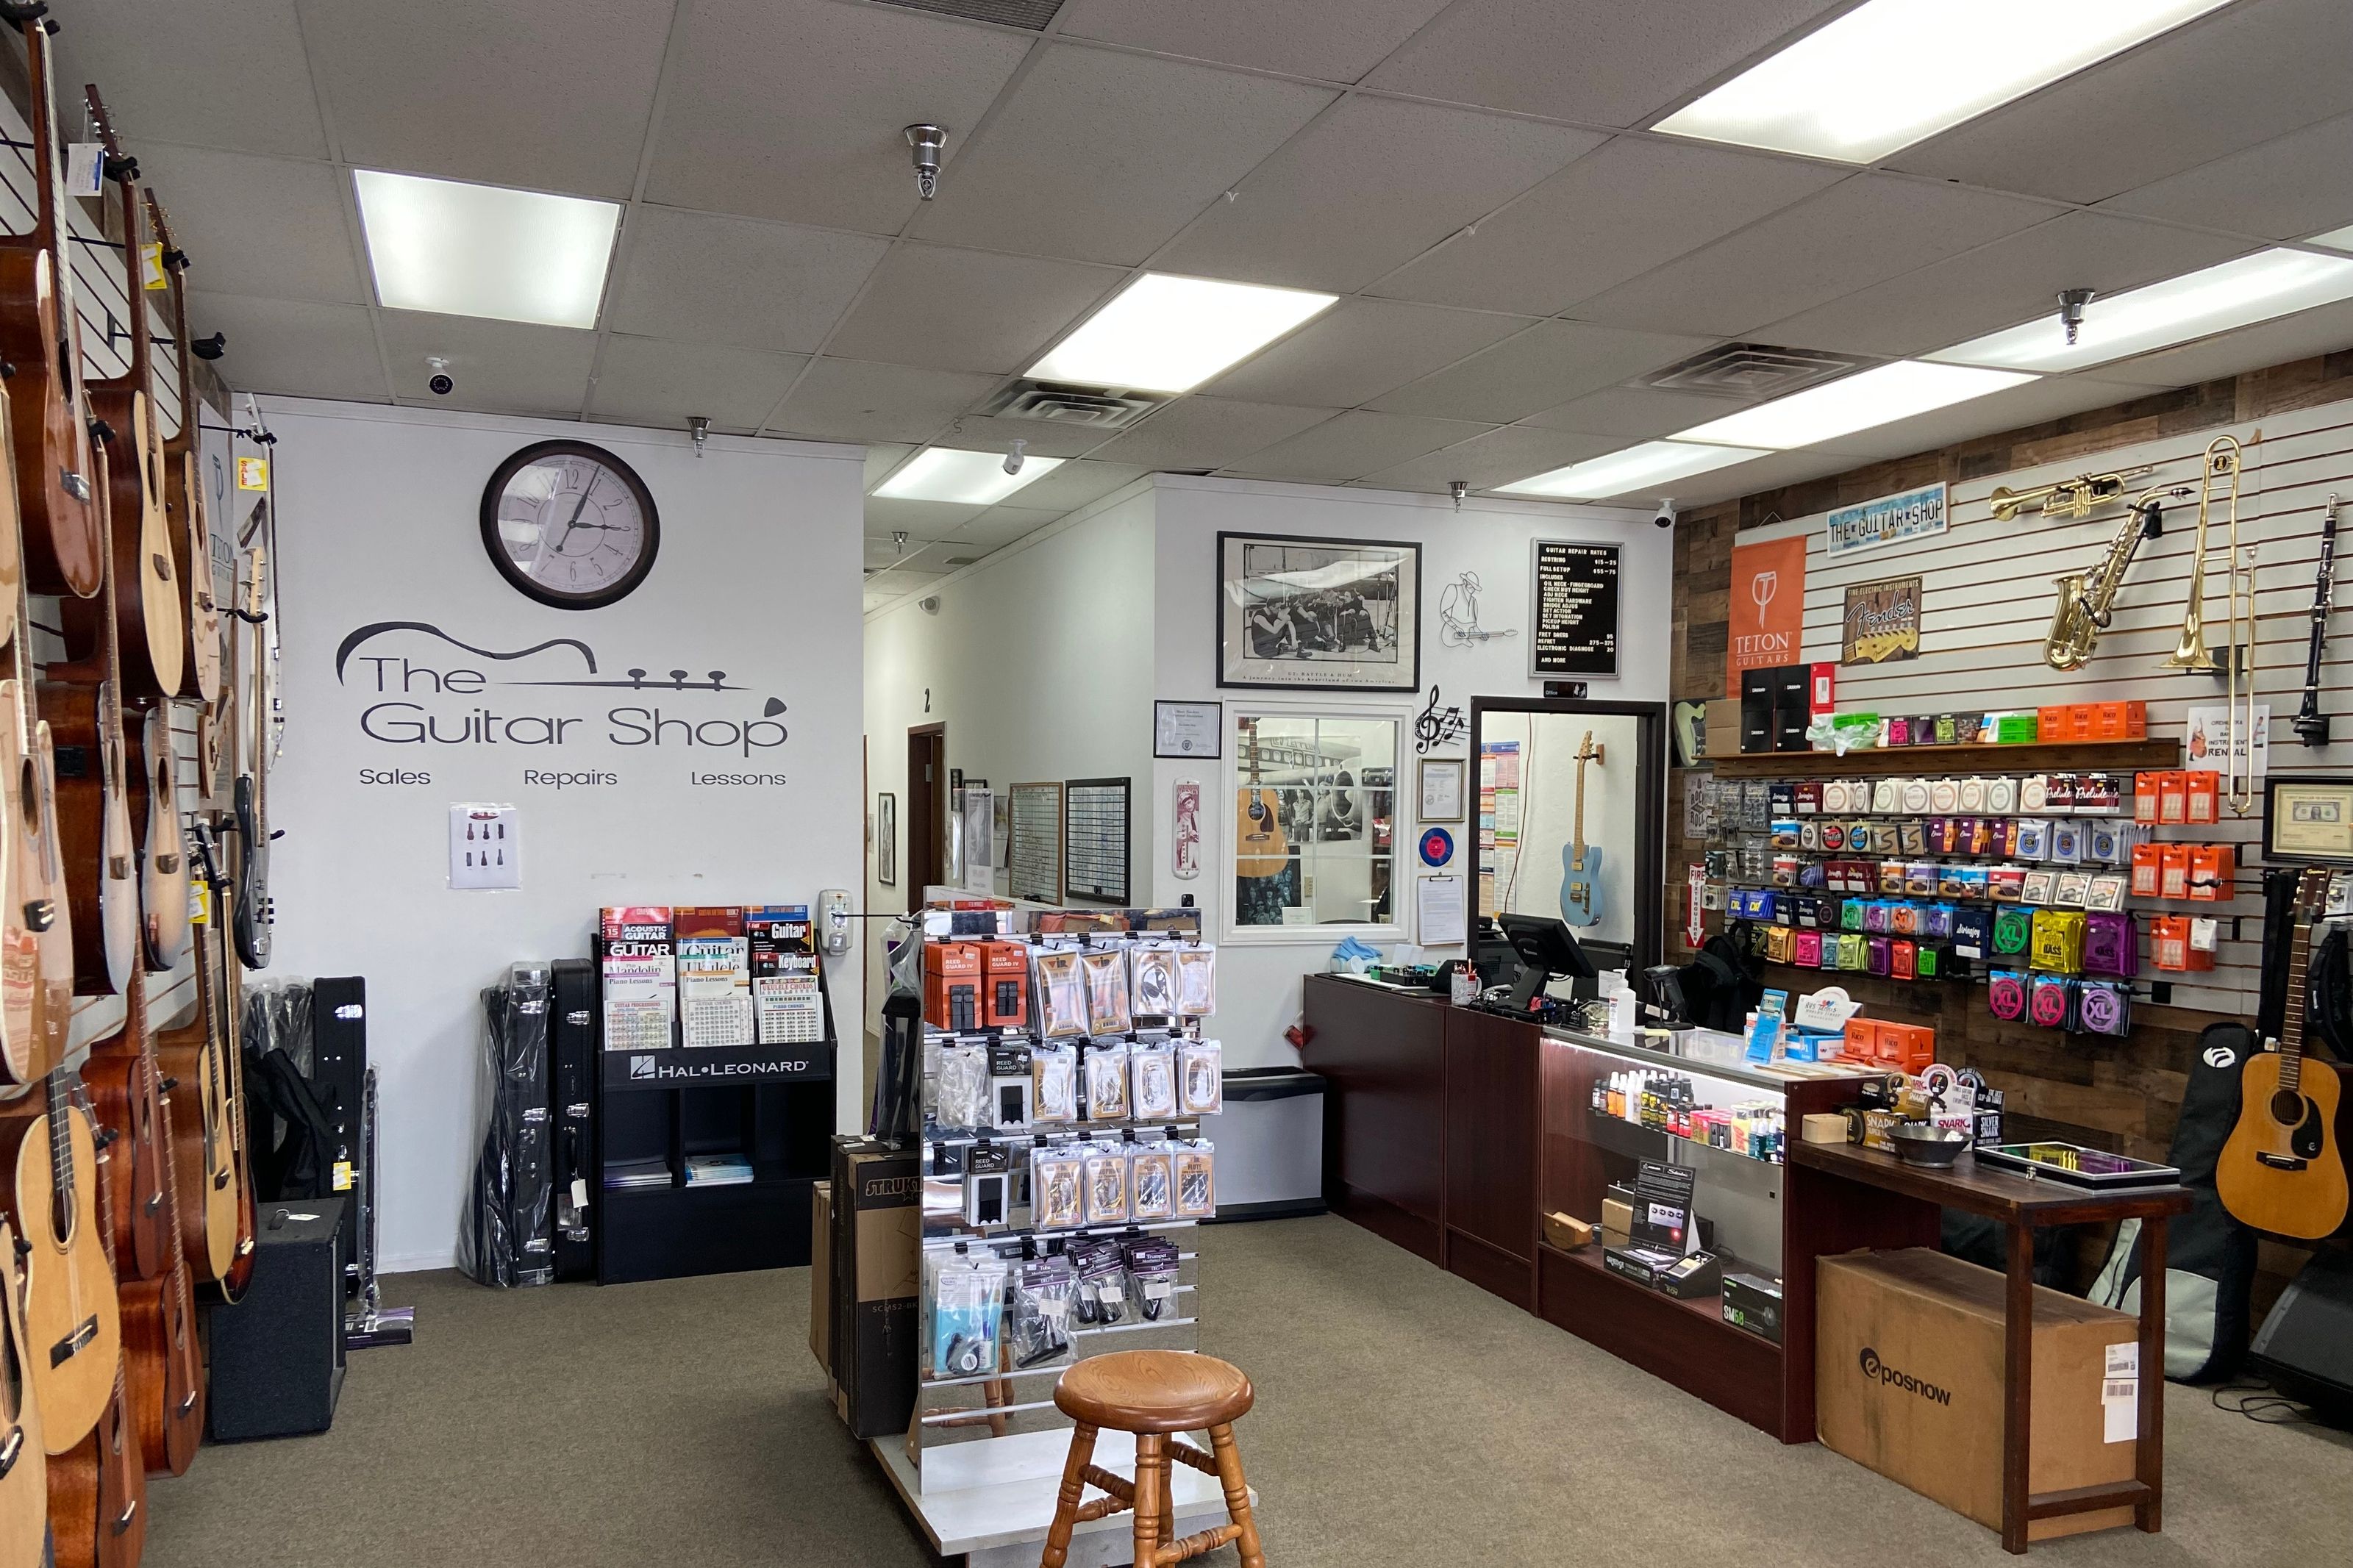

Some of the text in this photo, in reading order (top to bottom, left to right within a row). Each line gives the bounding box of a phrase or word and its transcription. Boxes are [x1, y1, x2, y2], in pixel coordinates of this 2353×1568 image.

[565, 469, 579, 490] 12
[590, 479, 601, 496] 1
[603, 498, 623, 511] 2
[1829, 498, 1943, 543] THE GUITAR SHOP
[604, 543, 624, 556] 4
[541, 554, 555, 572] 7
[590, 557, 604, 576] 5
[568, 561, 576, 582] 6
[1848, 579, 1919, 597] FINE ELECTRIC INSTRUMENTS
[1846, 589, 1915, 637] Fender
[1735, 631, 1789, 654] TETON
[1736, 654, 1788, 666] GUITARS
[359, 657, 486, 694] The
[924, 687, 930, 713] 2
[360, 702, 788, 758] Guitar Shop
[2208, 748, 2247, 756] RENAL
[360, 768, 787, 790] Sales Repairs Lessons
[2045, 787, 2072, 799] Prelude
[2075, 787, 2107, 799] Prelude
[1690, 870, 1705, 881] FIRE
[607, 928, 618, 936] 15
[771, 923, 807, 939] Guitar
[2002, 923, 2020, 942] XL
[610, 943, 670, 956] GUITAR
[686, 945, 744, 955] Guitar
[2043, 944, 2062, 956] BASS
[778, 954, 816, 970] Keyboard
[1996, 991, 2016, 1007] XL
[2039, 997, 2058, 1014] XL
[2088, 1001, 2111, 1020] XL
[1938, 1119, 1970, 1128] SNARK
[1980, 1116, 1999, 1127] SILVER
[1980, 1126, 1999, 1138] SNARK
[1724, 1305, 1744, 1326] SM58
